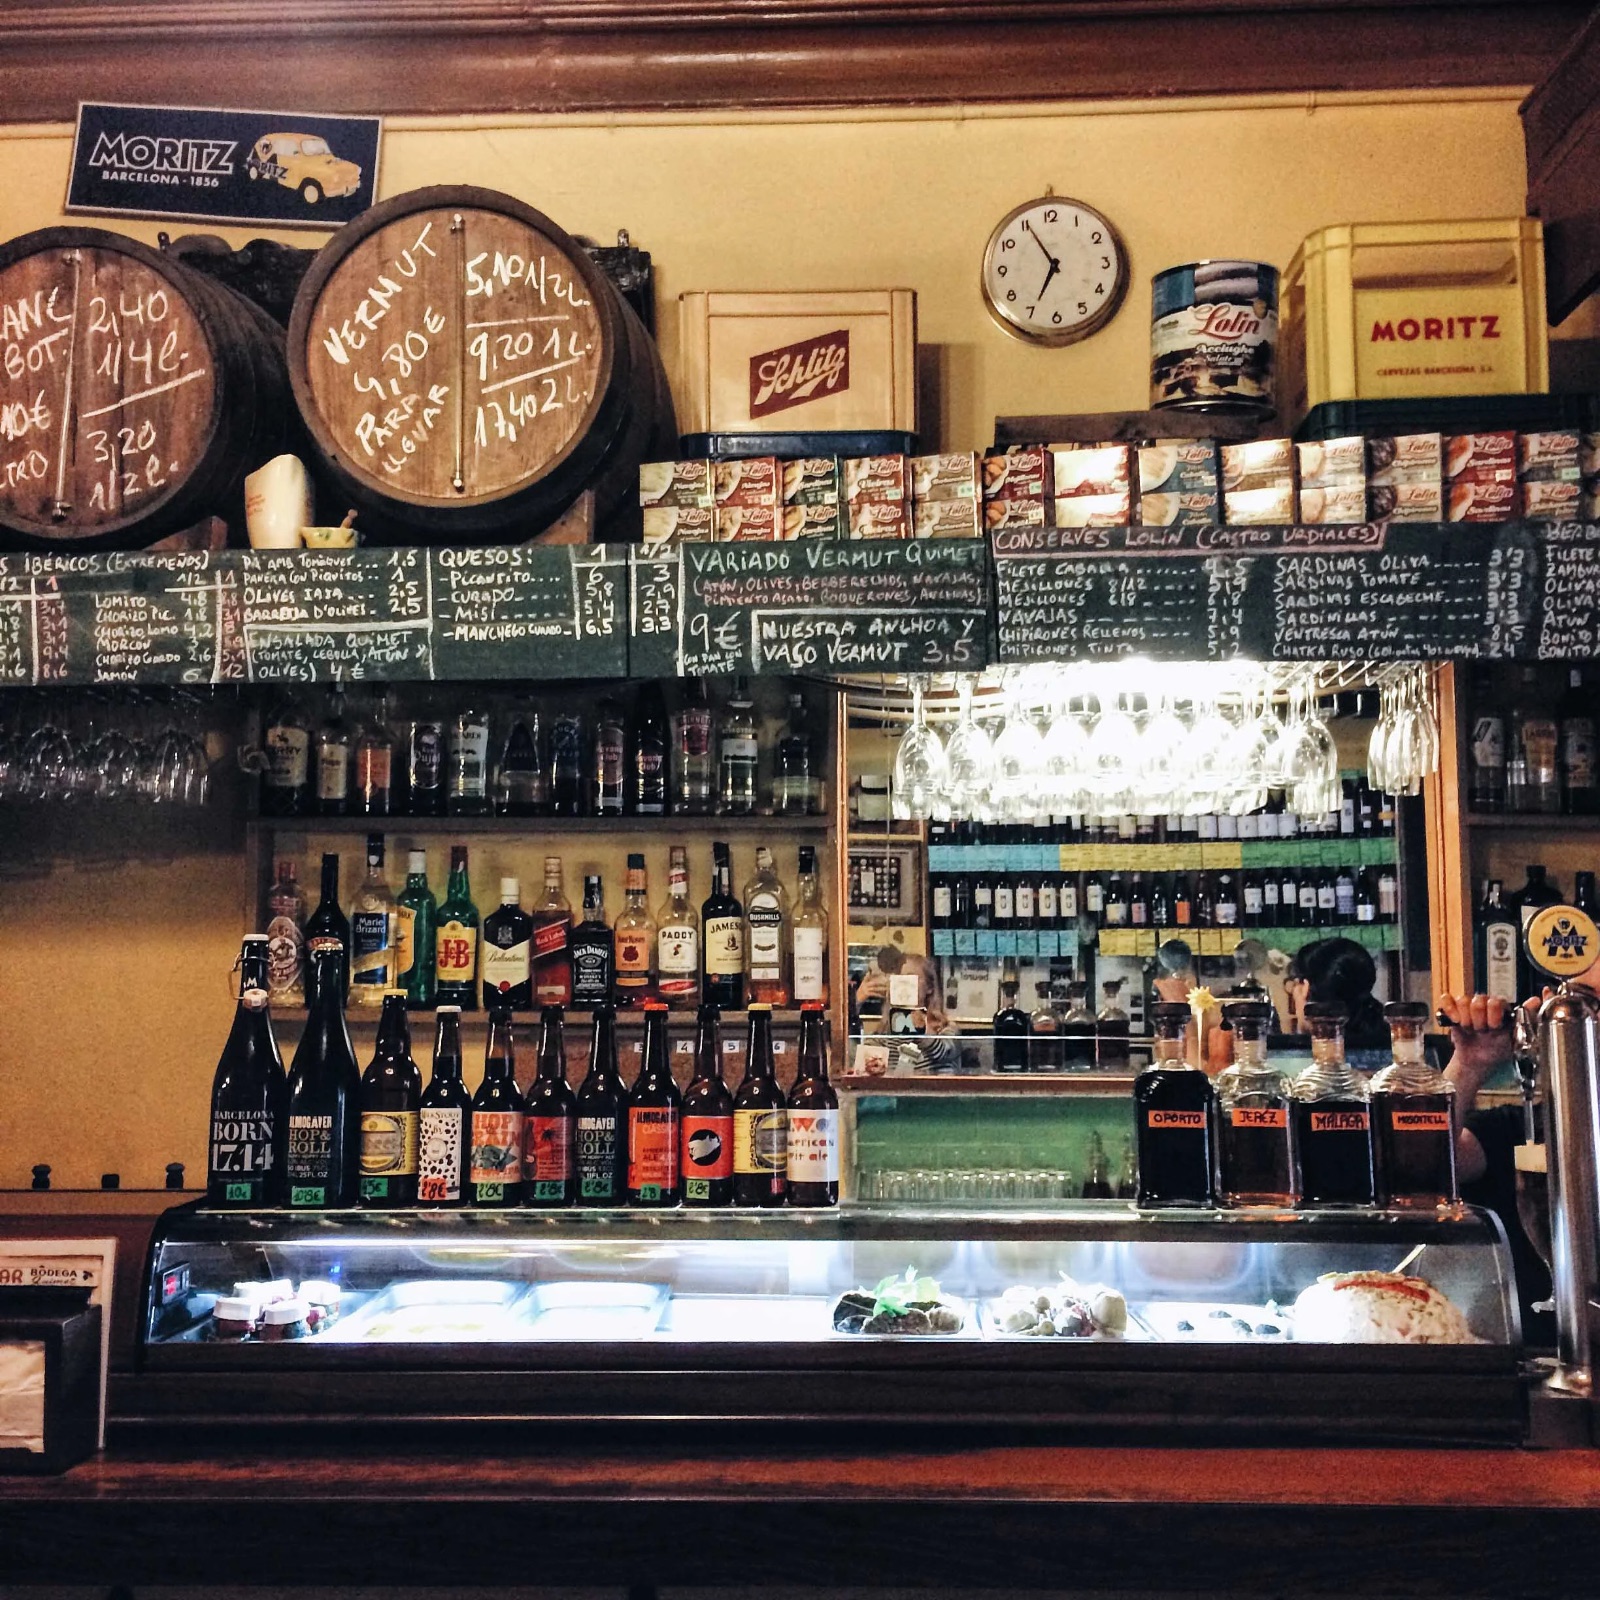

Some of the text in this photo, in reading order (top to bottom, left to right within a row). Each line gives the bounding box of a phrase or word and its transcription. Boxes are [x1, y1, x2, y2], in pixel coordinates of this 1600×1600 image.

[89, 131, 239, 176] MORITZ
[102, 170, 219, 188] BARCELONA 1856
[1044, 210, 1058, 223] 12
[1022, 220, 1031, 232] 11
[1002, 239, 1016, 252] 10
[1092, 232, 1102, 244] 2
[998, 265, 1008, 277] 9
[1101, 257, 1111, 269] 3
[324, 222, 436, 365] VERMUT
[1007, 290, 1017, 301] 8
[1095, 282, 1105, 295] 4
[89, 290, 169, 337] 2,40
[1026, 306, 1036, 319] 7
[1078, 302, 1088, 315] 5
[1052, 311, 1062, 324] 6
[1371, 315, 1501, 343] MORITZ
[469, 331, 534, 382] 9,20
[1376, 366, 1475, 377] CERVEZAS BARCELONA
[355, 394, 420, 457] PARA
[87, 420, 157, 472] 3,20
[996, 529, 1111, 552] CONSERVES
[1196, 527, 1272, 550] (CASTRO
[439, 548, 532, 568] QUESOS:
[591, 544, 606, 563] 1
[640, 544, 676, 560] 1/2
[690, 540, 985, 575] VARIADO VERMUT QUIMET
[1546, 545, 1595, 562] FILETE
[268, 556, 294, 571] AMB
[996, 559, 1047, 578] FILETE
[1275, 556, 1367, 578] SARDINAS
[1380, 555, 1430, 572] OLIVA
[290, 567, 404, 584] CON PIQUITOS 1
[589, 566, 603, 584] 6
[653, 564, 671, 583] 3
[997, 577, 1094, 594] MEJILLONES
[1273, 572, 1354, 593] SARDINAS
[1360, 573, 1422, 587] TOMATE
[243, 586, 295, 605] OLIVES
[389, 581, 419, 598] 2,5
[451, 582, 615, 605] CURADO 5,8
[641, 584, 676, 601] 2,9
[704, 592, 770, 606] PIMIENTO
[998, 593, 1087, 608] MEJILLONES
[1274, 591, 1352, 610] SARDINAS
[96, 594, 147, 608] LOMITO
[388, 598, 423, 616] 2,5
[95, 609, 148, 624] CHORIZO
[585, 600, 614, 619] 5,4
[998, 609, 1078, 624] NAVAJAS
[94, 626, 179, 639] CHORIZO LOMO
[455, 624, 526, 642] MANCHEGO
[586, 619, 614, 638] 6,5
[642, 618, 672, 635] 3,3
[762, 619, 857, 641] NUESTRA
[962, 617, 975, 638] Y
[998, 626, 1077, 641] CHIPIRONES
[1082, 625, 1147, 640] RELLENOS
[249, 631, 413, 650] ENSALADA QUIMET
[702, 651, 722, 663] PAN
[763, 638, 973, 668] VASO VERMUT 3,5
[1272, 643, 1332, 658] CHATKA
[1538, 644, 1591, 660] BONITO
[95, 653, 140, 667] CHORIZO
[183, 669, 202, 682] 6
[258, 662, 317, 682] OLIVES)
[687, 661, 736, 676] TOMATE
[359, 917, 384, 926] Marie
[750, 913, 780, 921] BUSHMILLS
[356, 924, 386, 934] Brizard
[662, 931, 694, 940] PADDY
[1542, 935, 1589, 947] MORITZ
[438, 939, 471, 969] J&B
[573, 947, 587, 960] JACK
[681, 1043, 689, 1052] 4
[728, 1042, 736, 1050] 5
[774, 1042, 781, 1050] 6
[214, 1110, 275, 1121] BARCELONA
[1154, 1113, 1202, 1124] OPORTO
[213, 1122, 275, 1142] BORN
[288, 1142, 331, 1154] ROLL
[212, 1143, 275, 1172] 17.14
[30, 1266, 78, 1278] BODEGA
